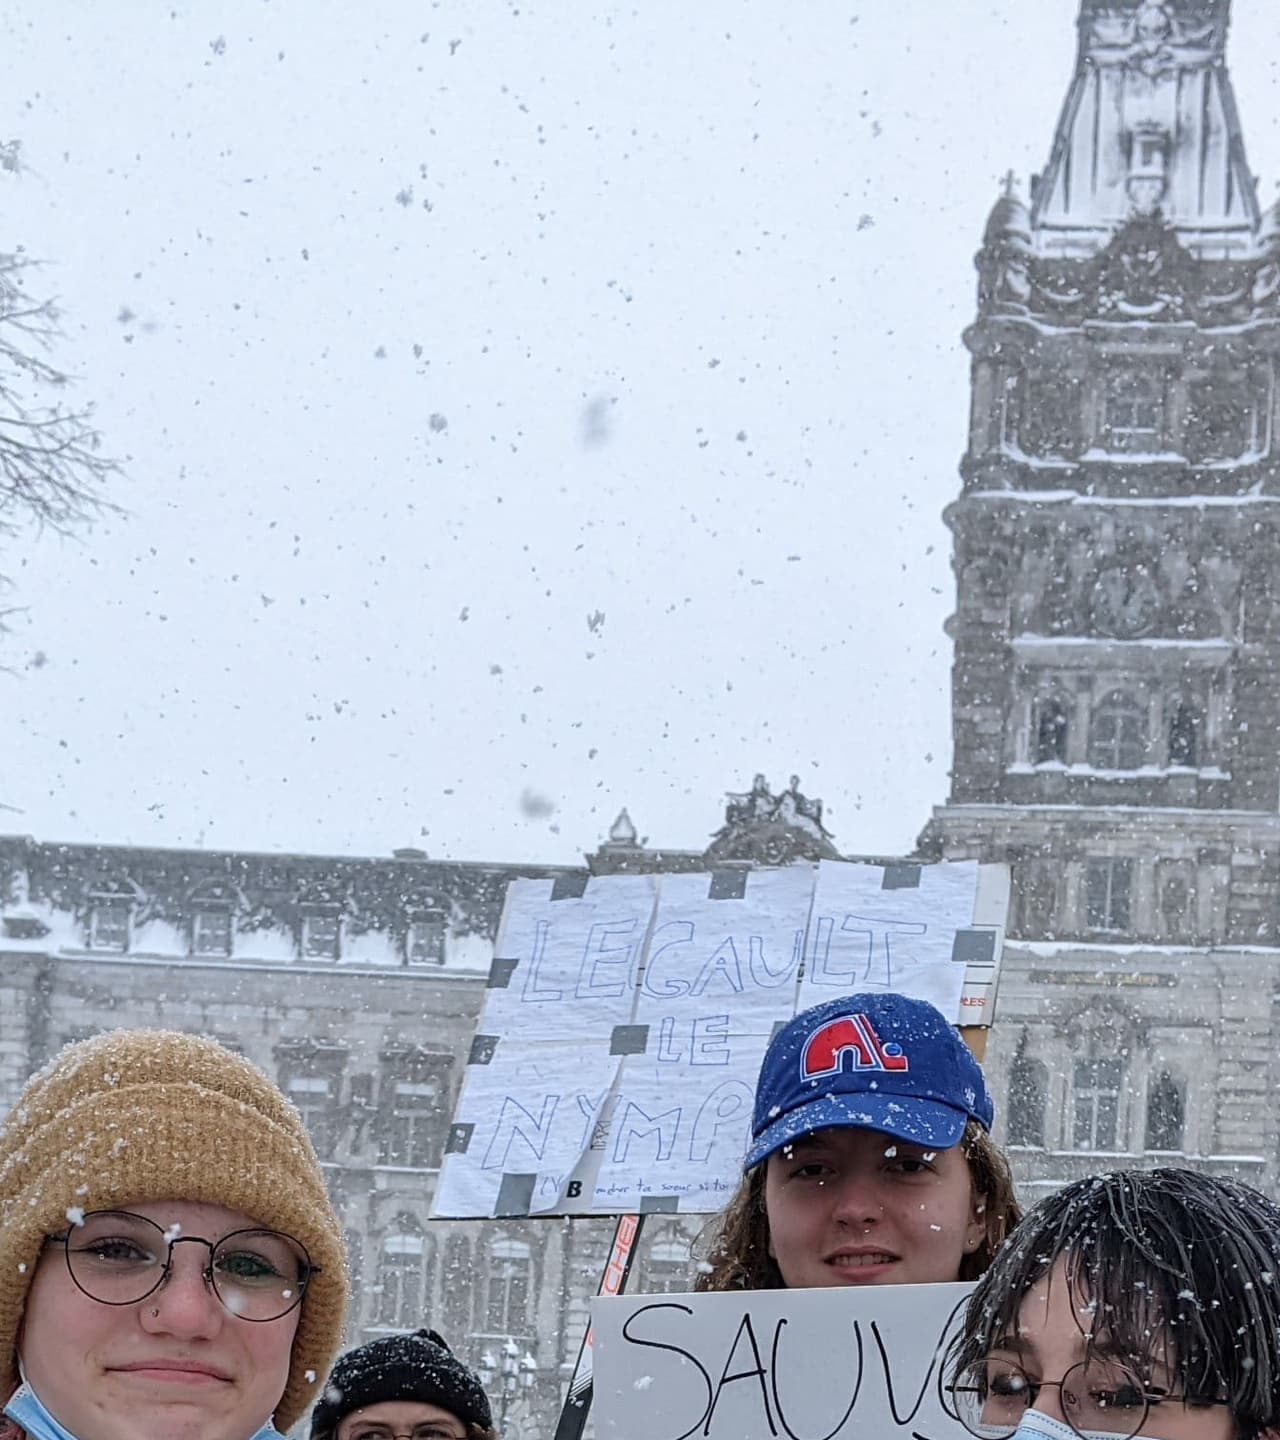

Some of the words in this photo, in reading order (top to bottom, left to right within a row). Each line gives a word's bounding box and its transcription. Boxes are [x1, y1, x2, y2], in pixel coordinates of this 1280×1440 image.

[521, 915, 927, 1002] LEGAULT
[656, 1014, 730, 1066] LE
[481, 1079, 754, 1170] NYMP
